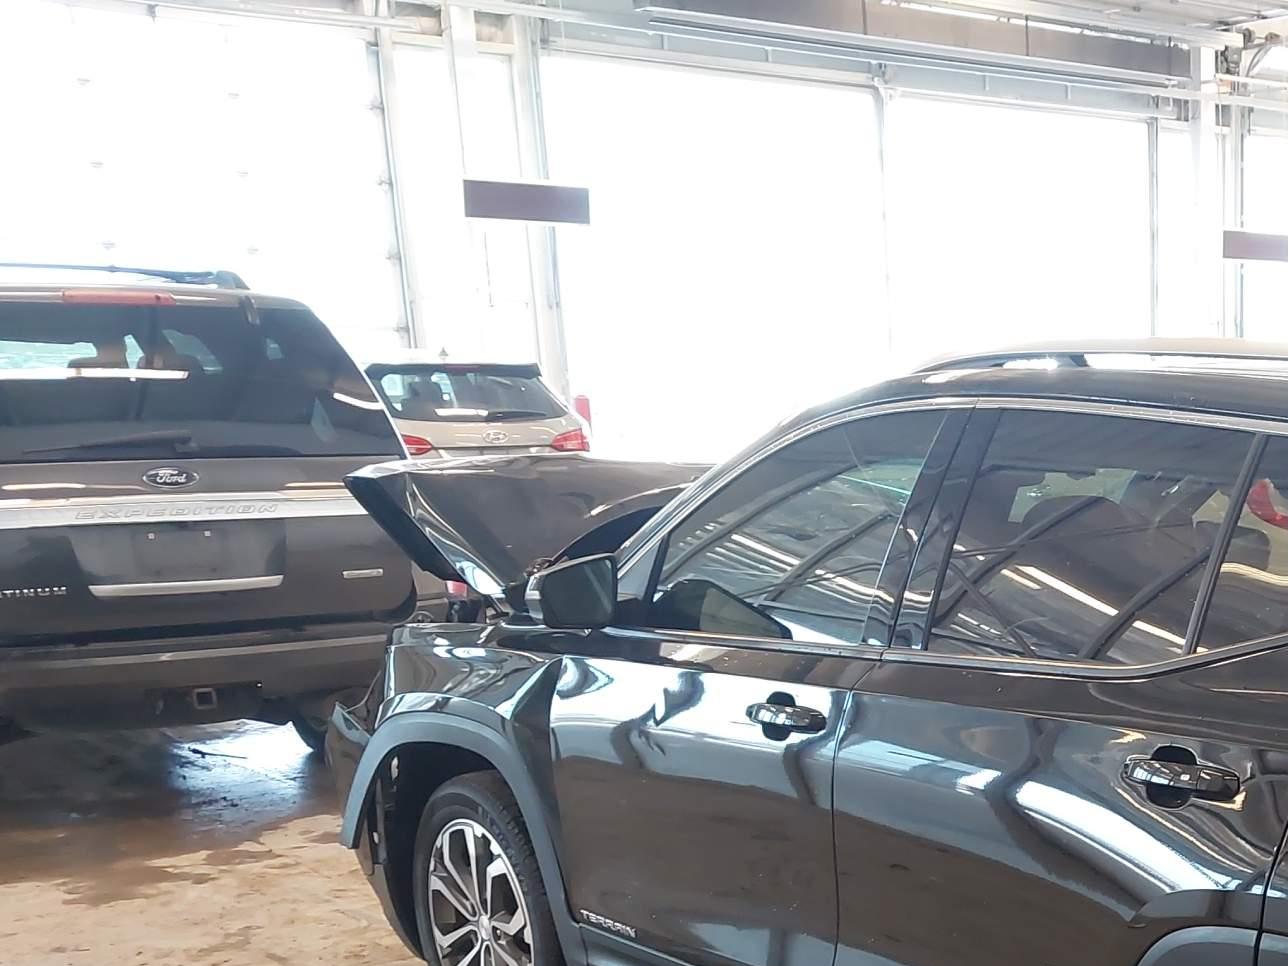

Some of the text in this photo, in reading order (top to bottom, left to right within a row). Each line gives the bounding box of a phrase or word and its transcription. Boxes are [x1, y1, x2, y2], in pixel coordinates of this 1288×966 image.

[156, 470, 187, 483] Ford
[75, 503, 279, 520] EXPEDITION
[0, 586, 67, 599] TINUM
[580, 909, 637, 938] TERRAIN
